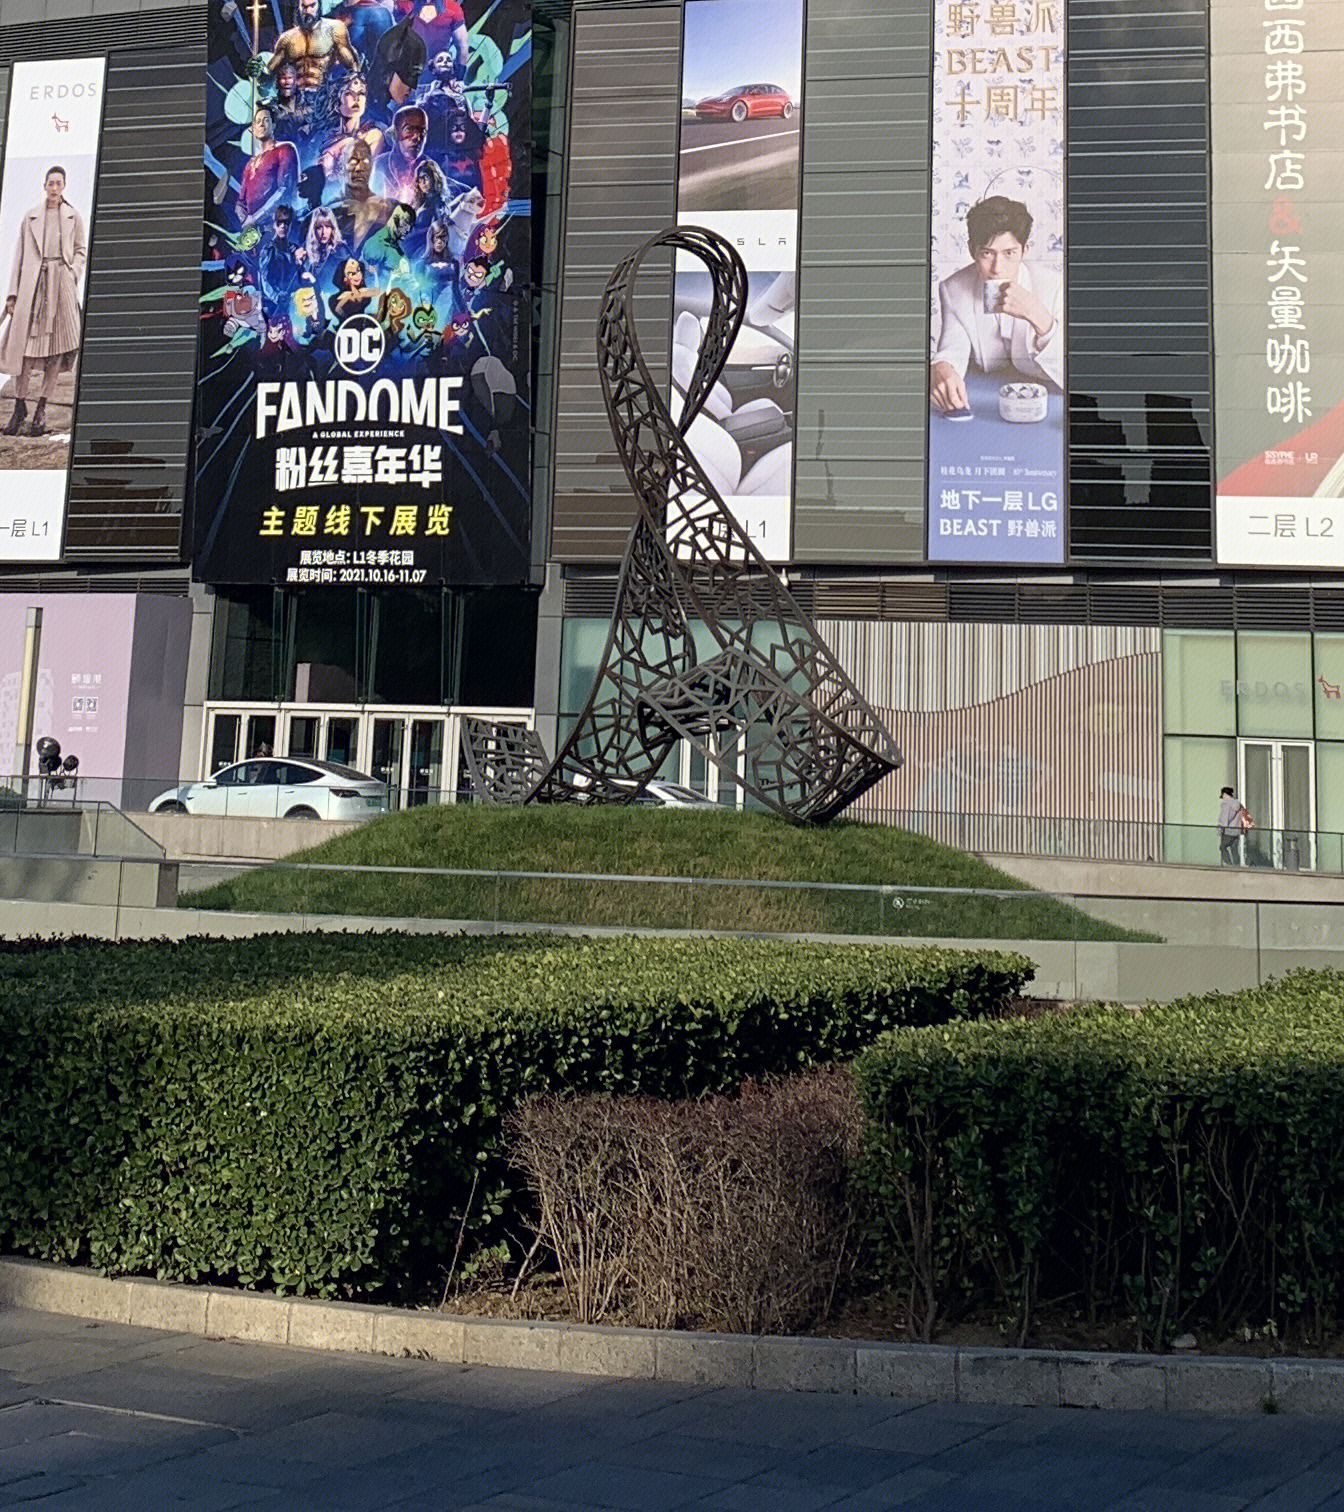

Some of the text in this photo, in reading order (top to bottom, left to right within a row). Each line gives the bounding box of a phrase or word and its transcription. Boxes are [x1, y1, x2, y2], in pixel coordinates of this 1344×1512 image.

[946, 45, 1059, 75] BEAST
[30, 82, 97, 100] ERDOS
[945, 85, 1057, 122] 十周年
[337, 328, 381, 363] DC
[256, 377, 464, 439] FANDOME
[354, 430, 405, 438] EXPERIENCE
[275, 444, 443, 492] 粉丝嘉年华
[940, 489, 1057, 511] 地下一层 LG
[31, 521, 48, 536] L1
[259, 504, 454, 536] 主题线下展览
[939, 518, 1057, 538] BEAST 野兽派
[1248, 514, 1334, 538] 二层 L2
[1220, 680, 1305, 699] ERDOS
